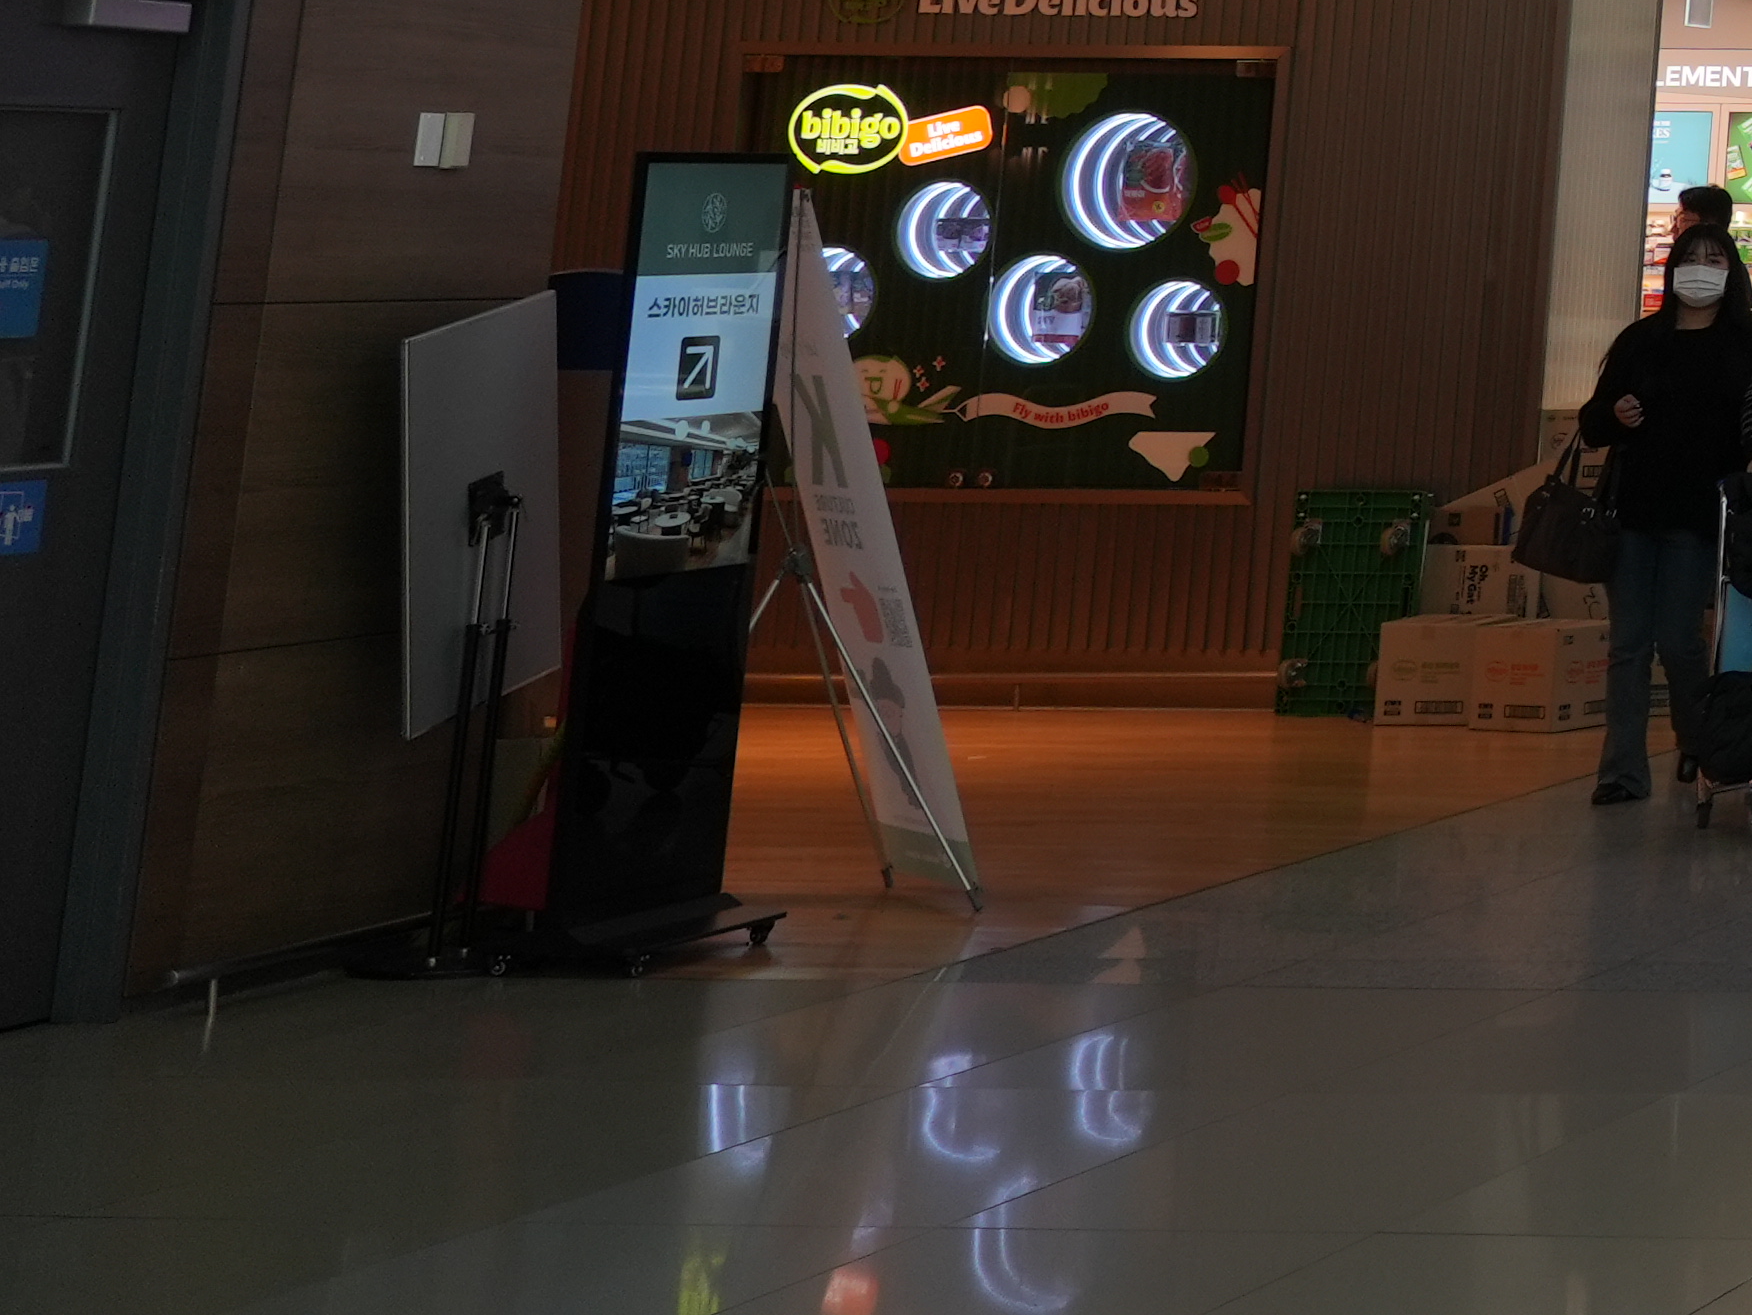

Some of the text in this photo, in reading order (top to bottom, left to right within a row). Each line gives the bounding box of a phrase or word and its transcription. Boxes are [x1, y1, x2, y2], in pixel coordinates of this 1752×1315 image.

[801, 108, 901, 148] bibigo
[926, 119, 961, 138] Live
[816, 138, 860, 155] 비비고
[909, 130, 983, 159] Delicious
[666, 242, 754, 259] SKY HUB LOUNGE
[647, 292, 760, 320] 스카이허브라운지
[1012, 401, 1110, 424] Fly with bibigo
